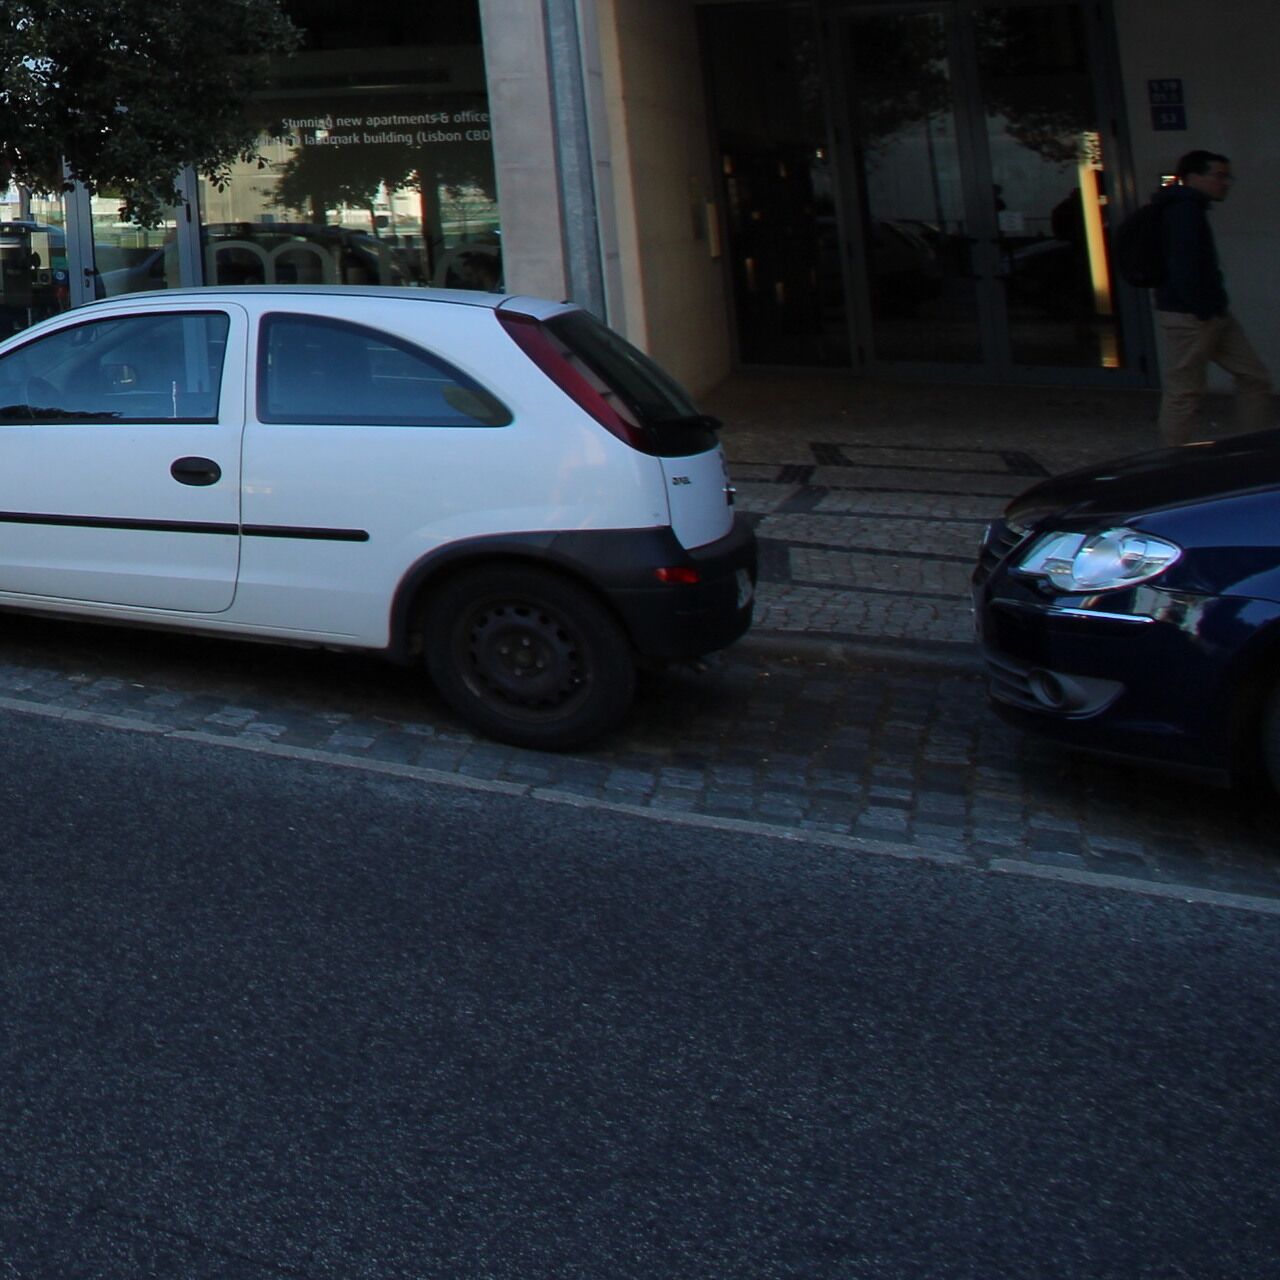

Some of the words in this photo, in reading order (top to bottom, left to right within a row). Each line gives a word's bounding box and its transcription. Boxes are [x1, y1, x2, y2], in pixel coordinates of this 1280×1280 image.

[281, 116, 333, 130] Stunning
[336, 117, 363, 128] new
[366, 113, 435, 129] apartments
[453, 110, 490, 123] office
[364, 129, 413, 145] building
[416, 130, 462, 144] (Lisbon
